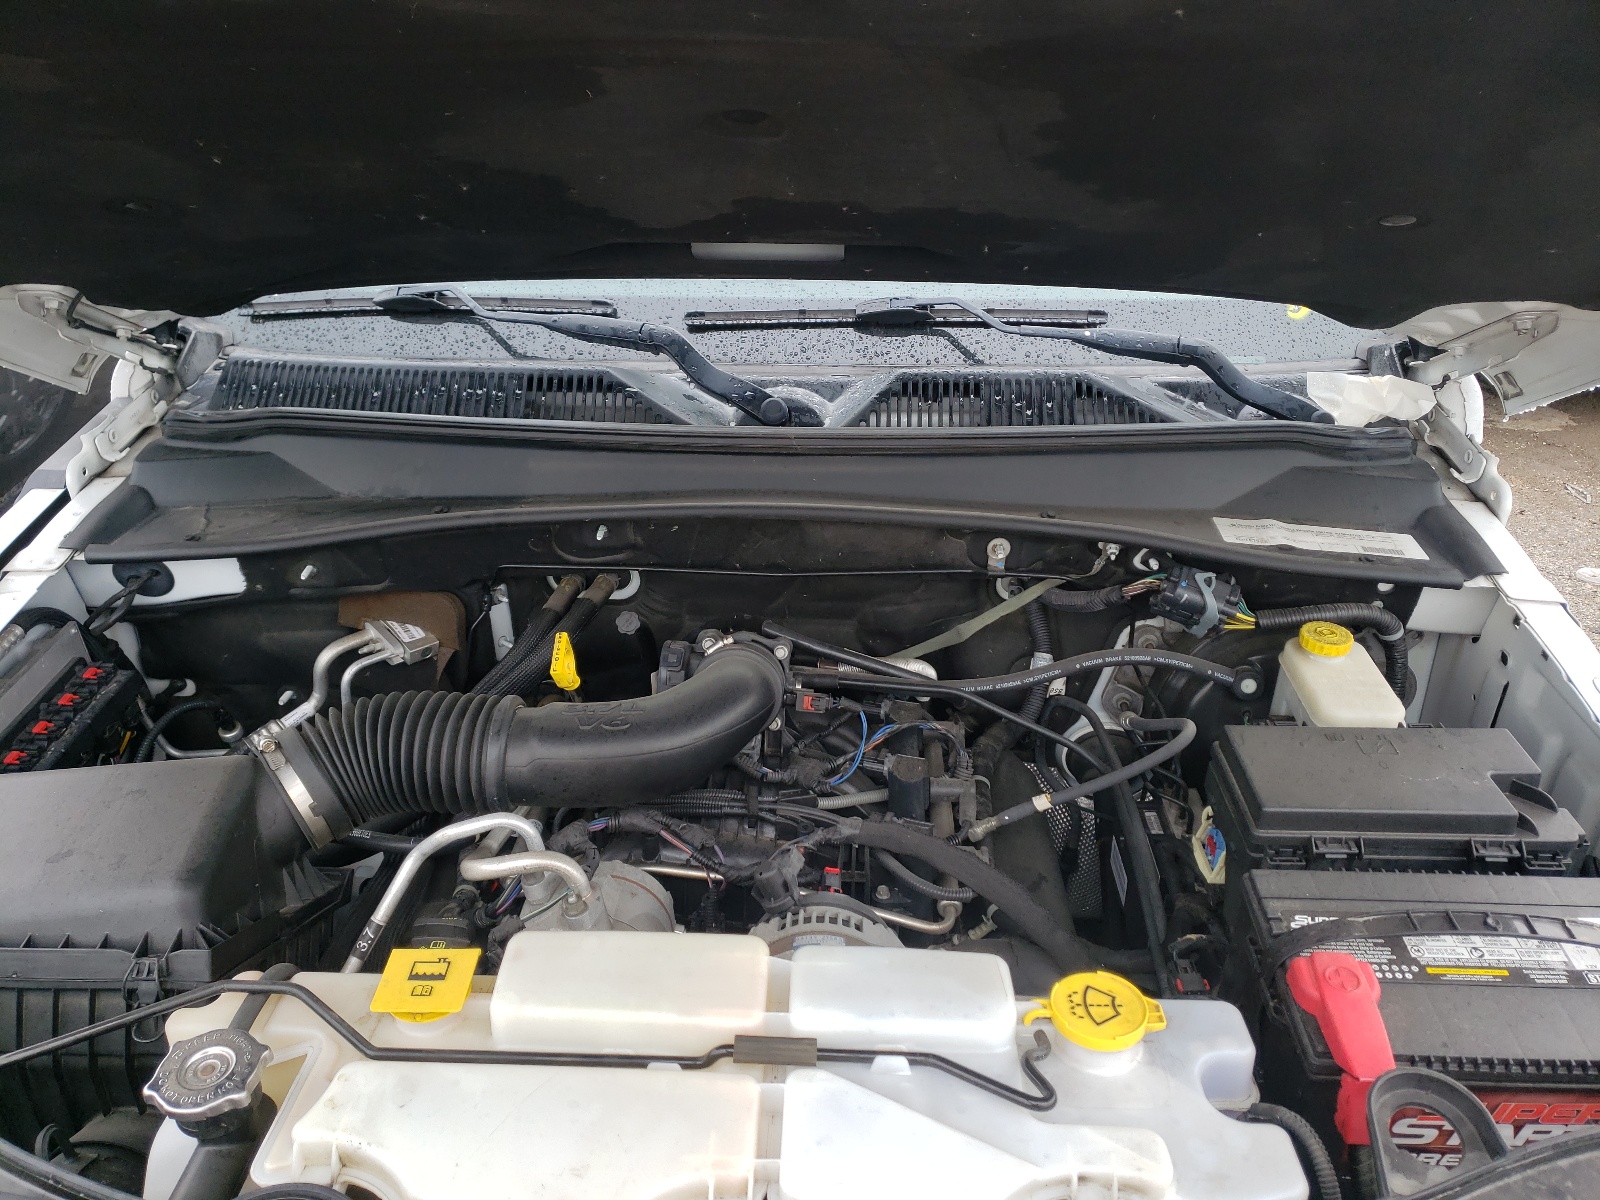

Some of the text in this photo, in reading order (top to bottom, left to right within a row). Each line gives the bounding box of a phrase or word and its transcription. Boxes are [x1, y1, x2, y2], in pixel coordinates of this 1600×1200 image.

[1082, 658, 1104, 667] VACUUM
[1105, 655, 1122, 663] BRAKE
[356, 927, 374, 951] 3.7
[180, 1093, 215, 1104] OPEN
